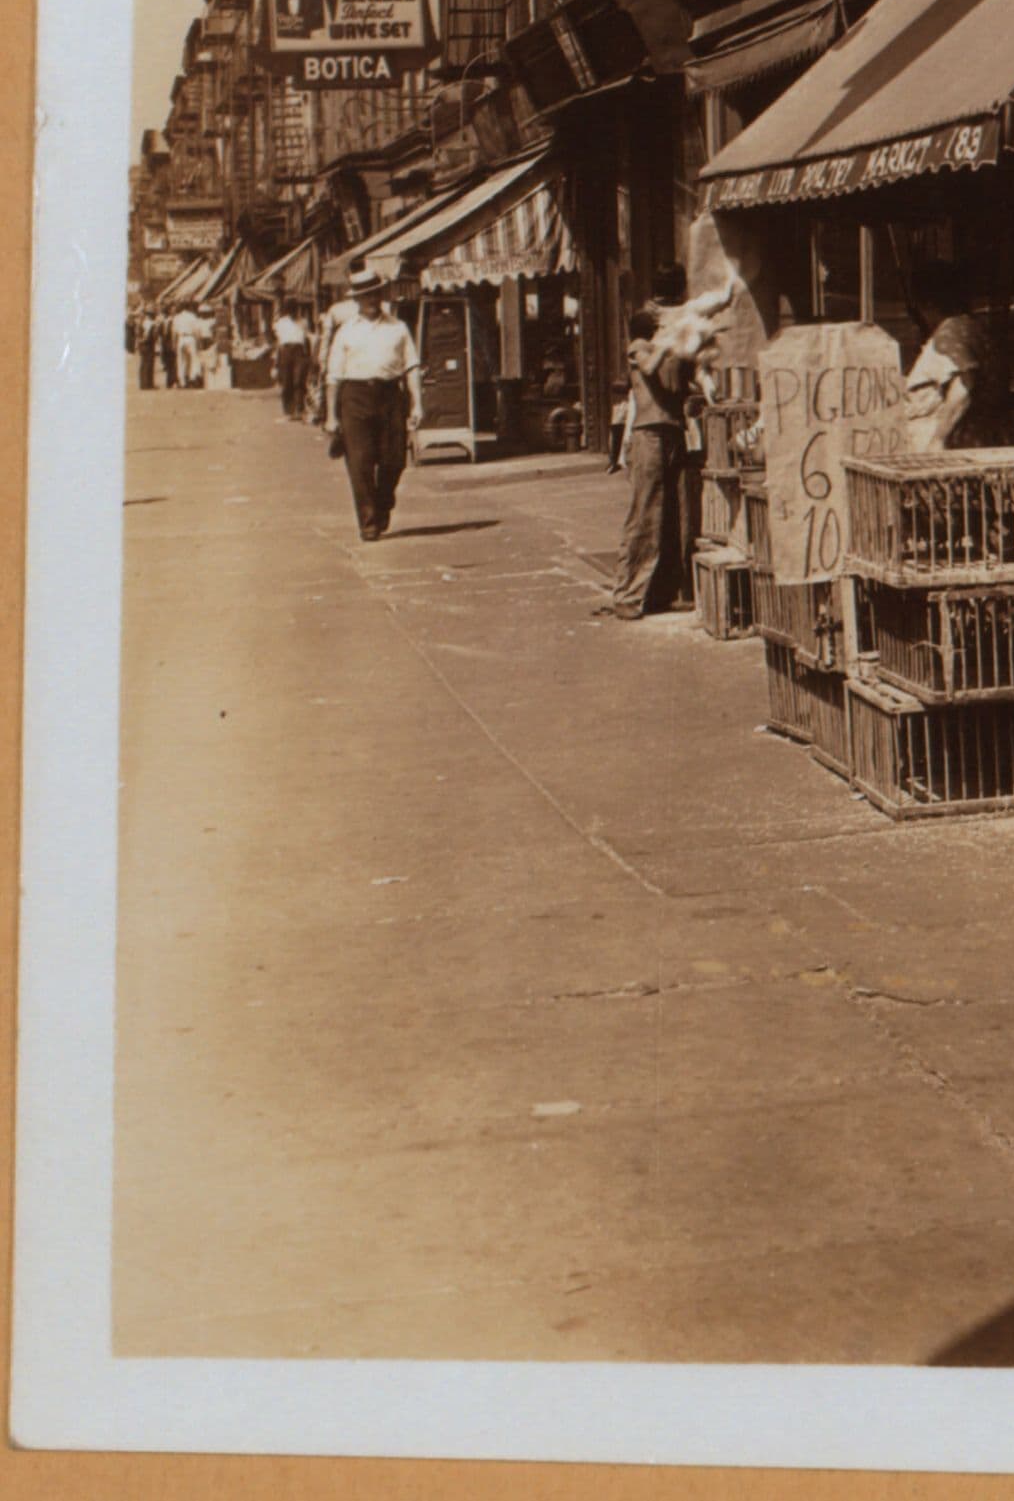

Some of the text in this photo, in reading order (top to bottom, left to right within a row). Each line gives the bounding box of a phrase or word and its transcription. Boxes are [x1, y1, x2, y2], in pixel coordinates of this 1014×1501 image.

[380, 21, 413, 39] SET
[304, 55, 391, 81] BOTICA
[861, 135, 932, 182] MARKET
[763, 366, 901, 436] PIGEONS
[801, 429, 833, 501] 6
